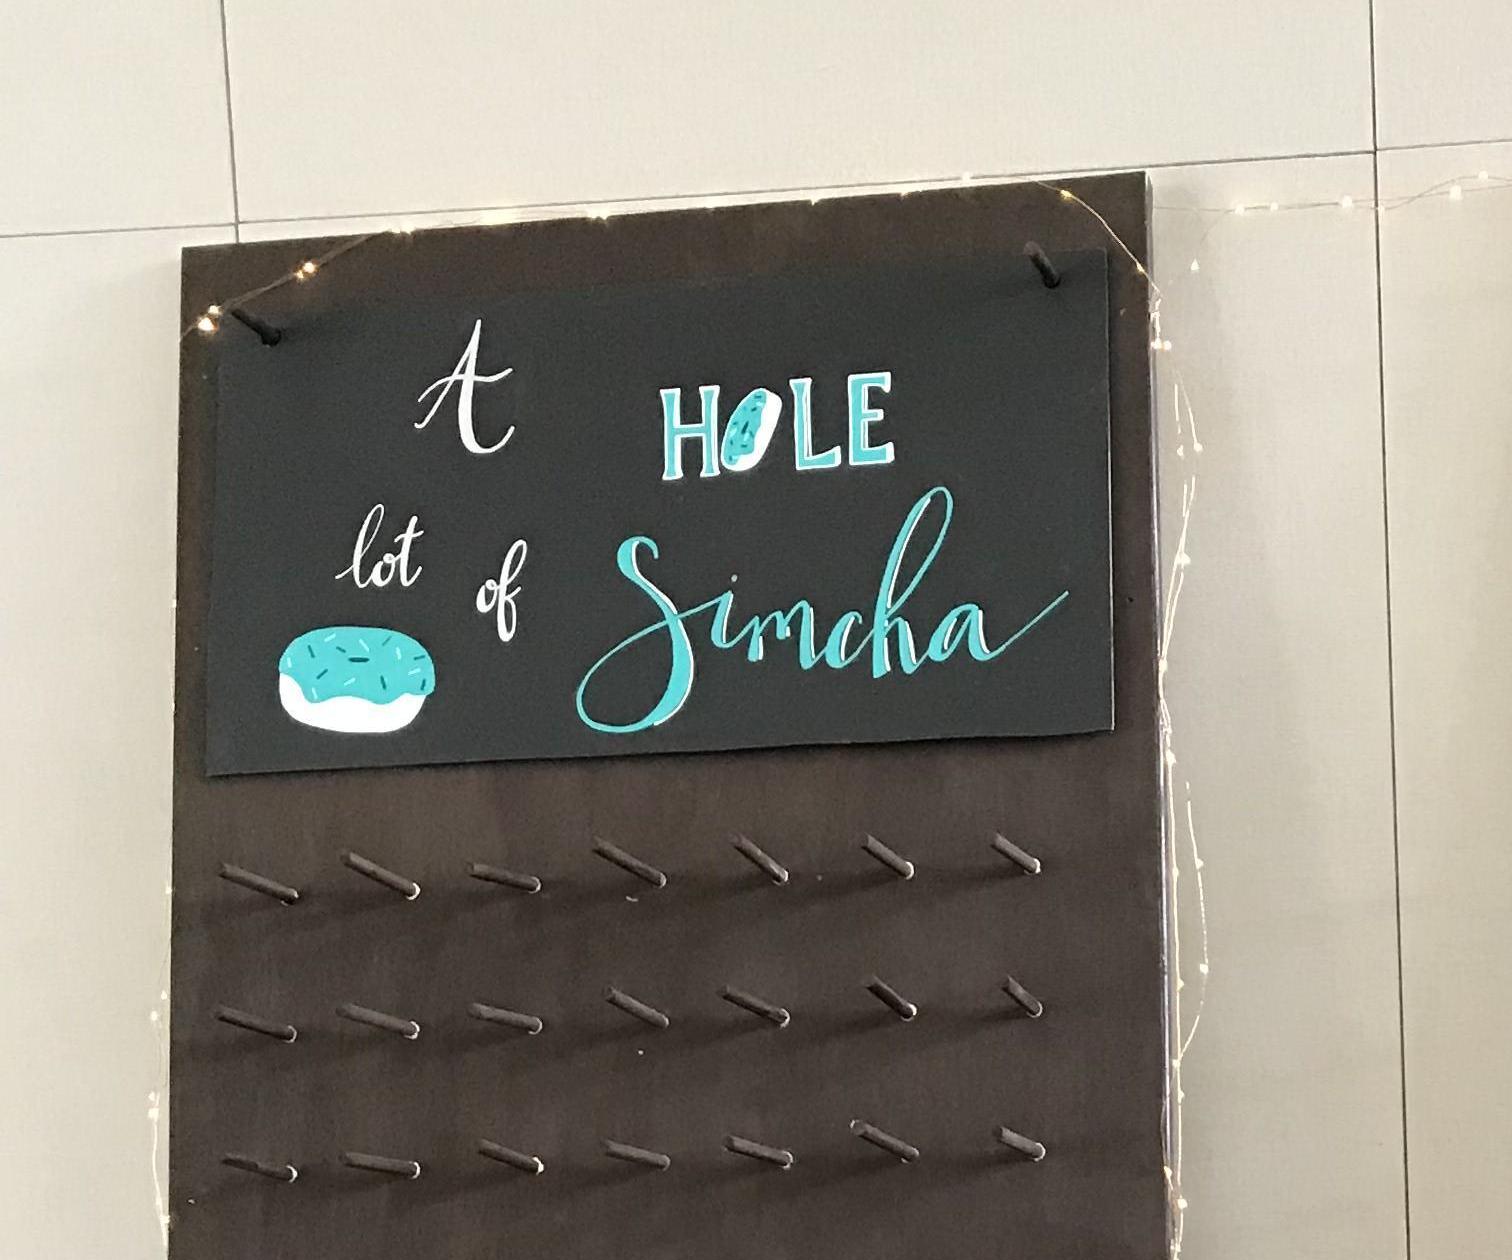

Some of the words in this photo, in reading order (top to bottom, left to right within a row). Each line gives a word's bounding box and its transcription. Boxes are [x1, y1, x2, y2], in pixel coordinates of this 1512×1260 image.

[414, 319, 515, 454] A
[660, 372, 895, 481] HOLE
[335, 504, 424, 588] lot
[476, 540, 527, 642] of
[576, 486, 1069, 733] Simcha
